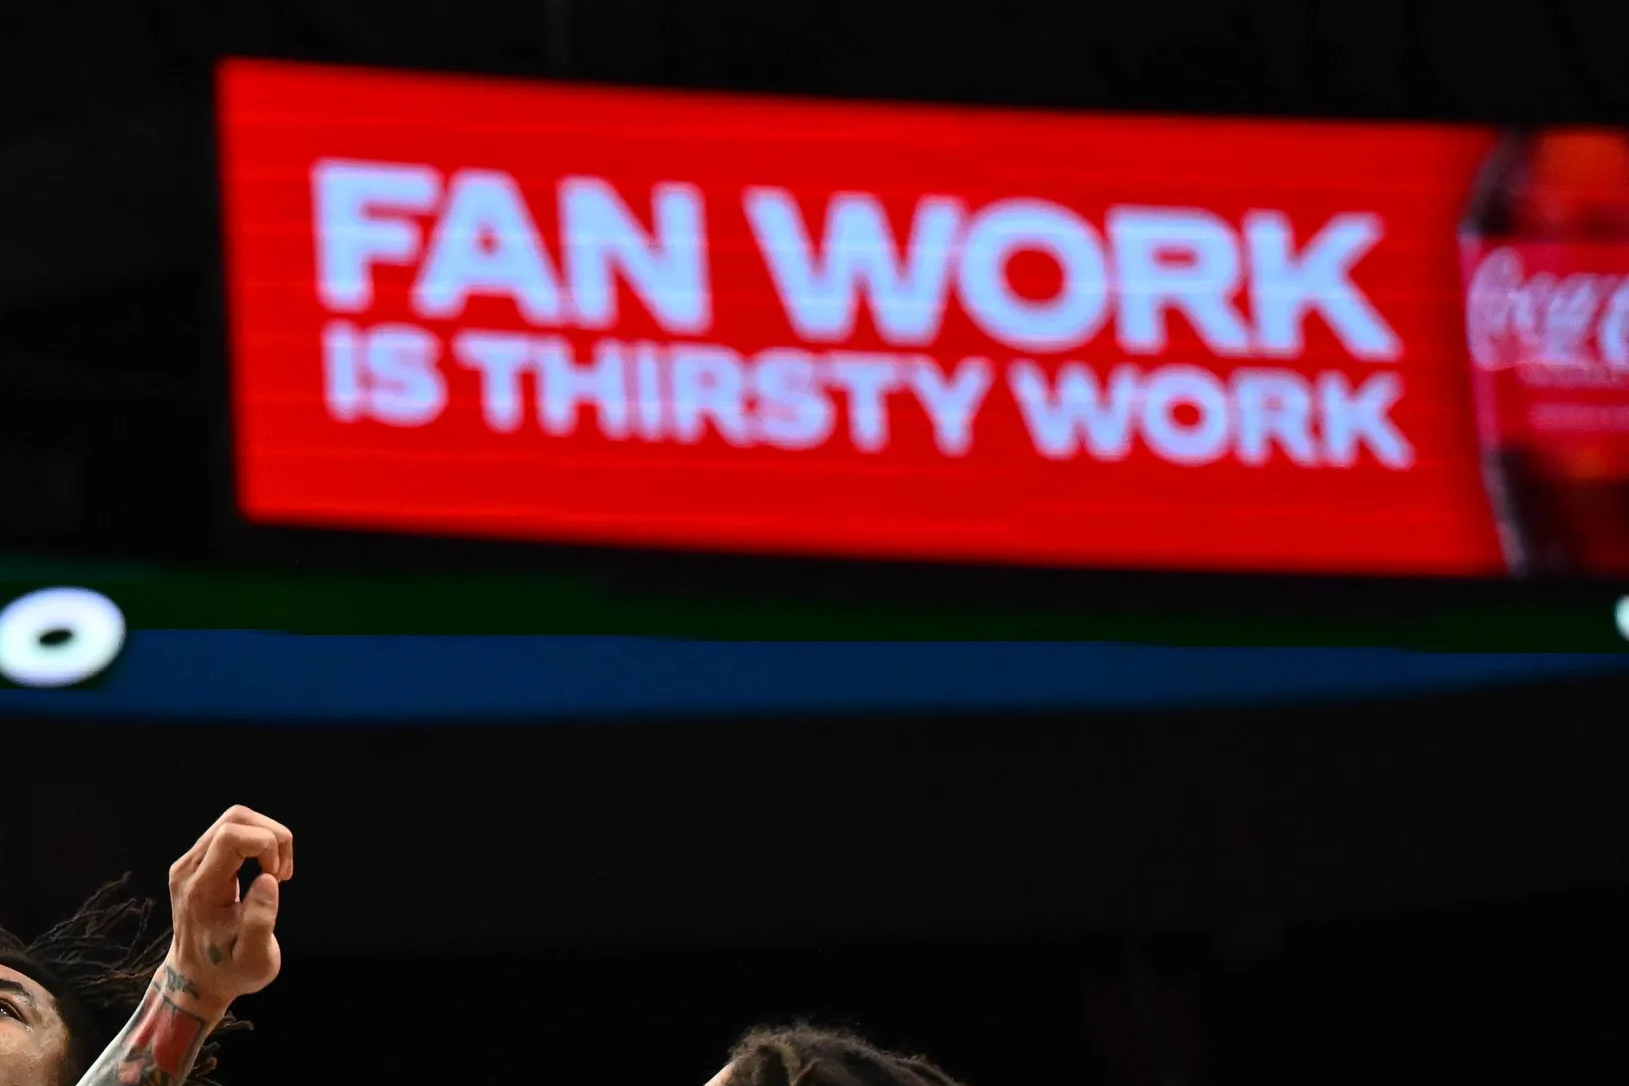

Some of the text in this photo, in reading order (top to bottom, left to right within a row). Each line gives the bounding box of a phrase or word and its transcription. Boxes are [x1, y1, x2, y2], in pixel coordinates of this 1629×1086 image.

[310, 157, 1402, 361] FAN WORK
[323, 320, 1414, 470] IS THIRSTY WORK
